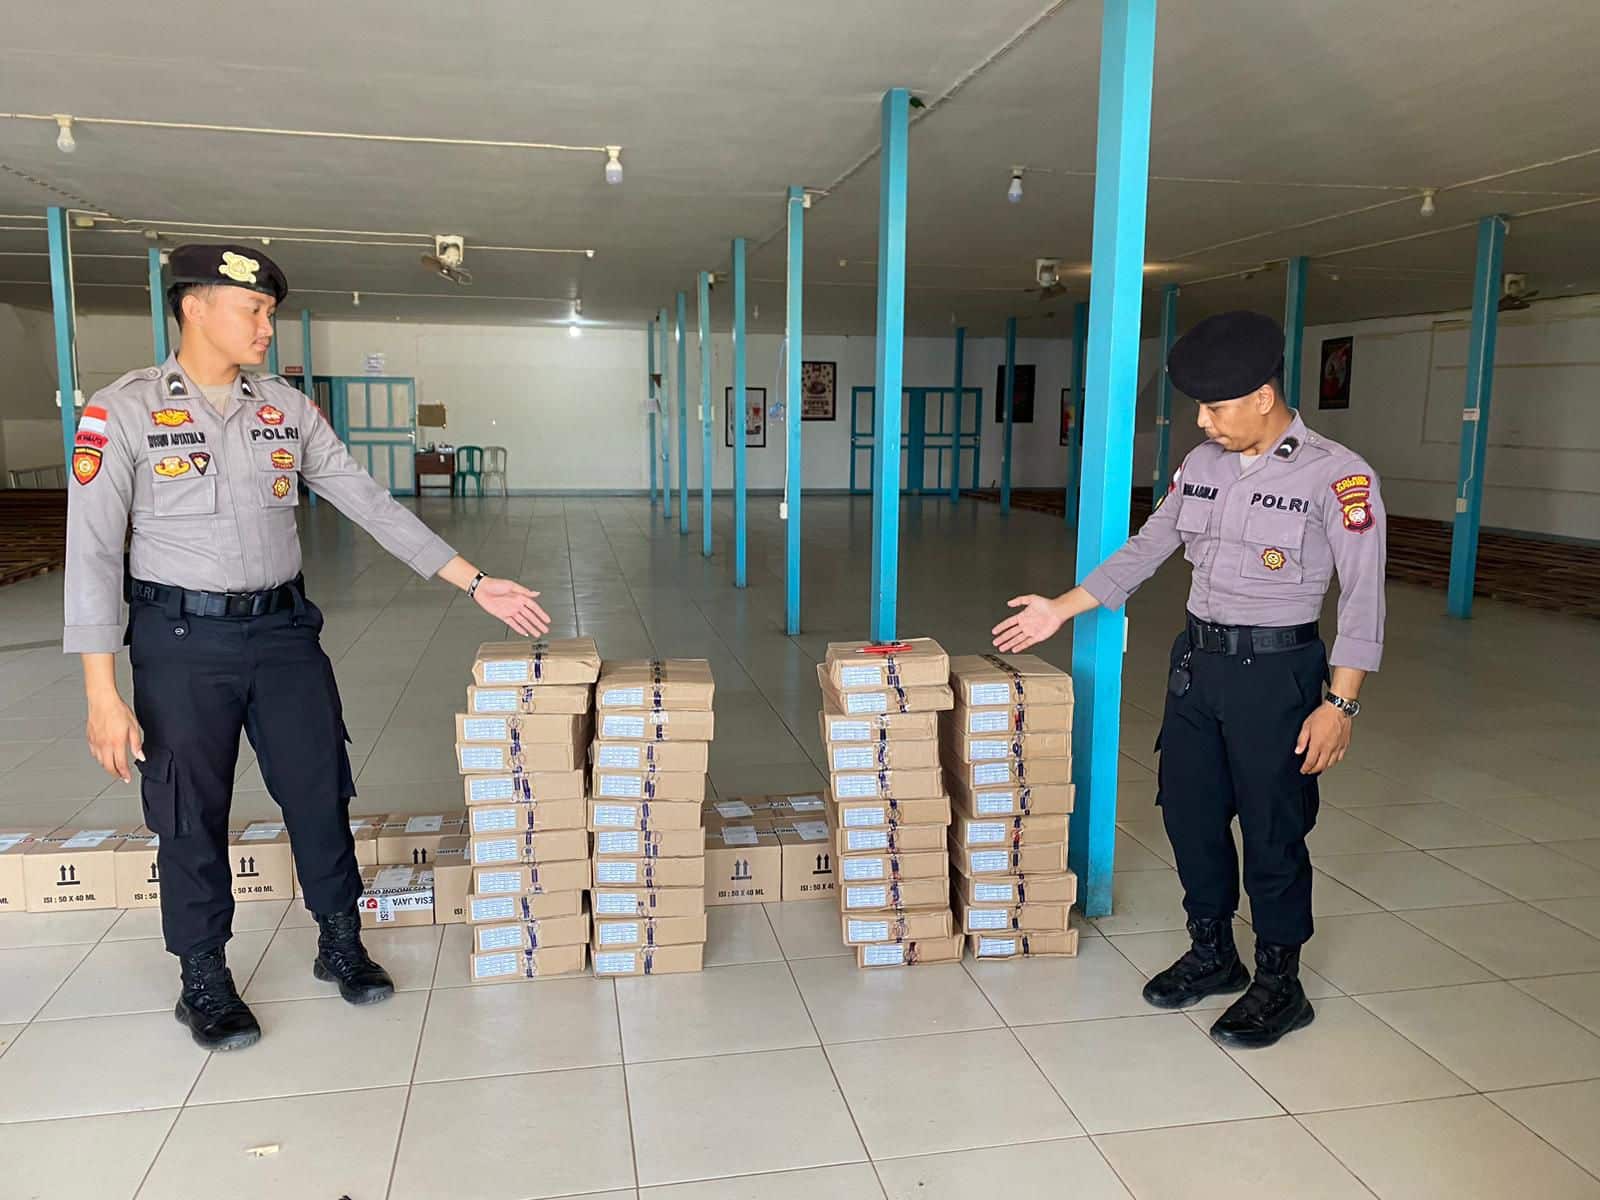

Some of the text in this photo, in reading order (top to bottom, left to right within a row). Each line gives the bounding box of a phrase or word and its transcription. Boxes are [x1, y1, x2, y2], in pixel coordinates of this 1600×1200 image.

[250, 427, 299, 441] POLRI
[1250, 493, 1309, 513] POLRI
[59, 895, 67, 903] 50
[75, 894, 84, 902] 40
[85, 893, 96, 901] ML
[148, 892, 158, 900] 50
[392, 897, 412, 906] JAYA
